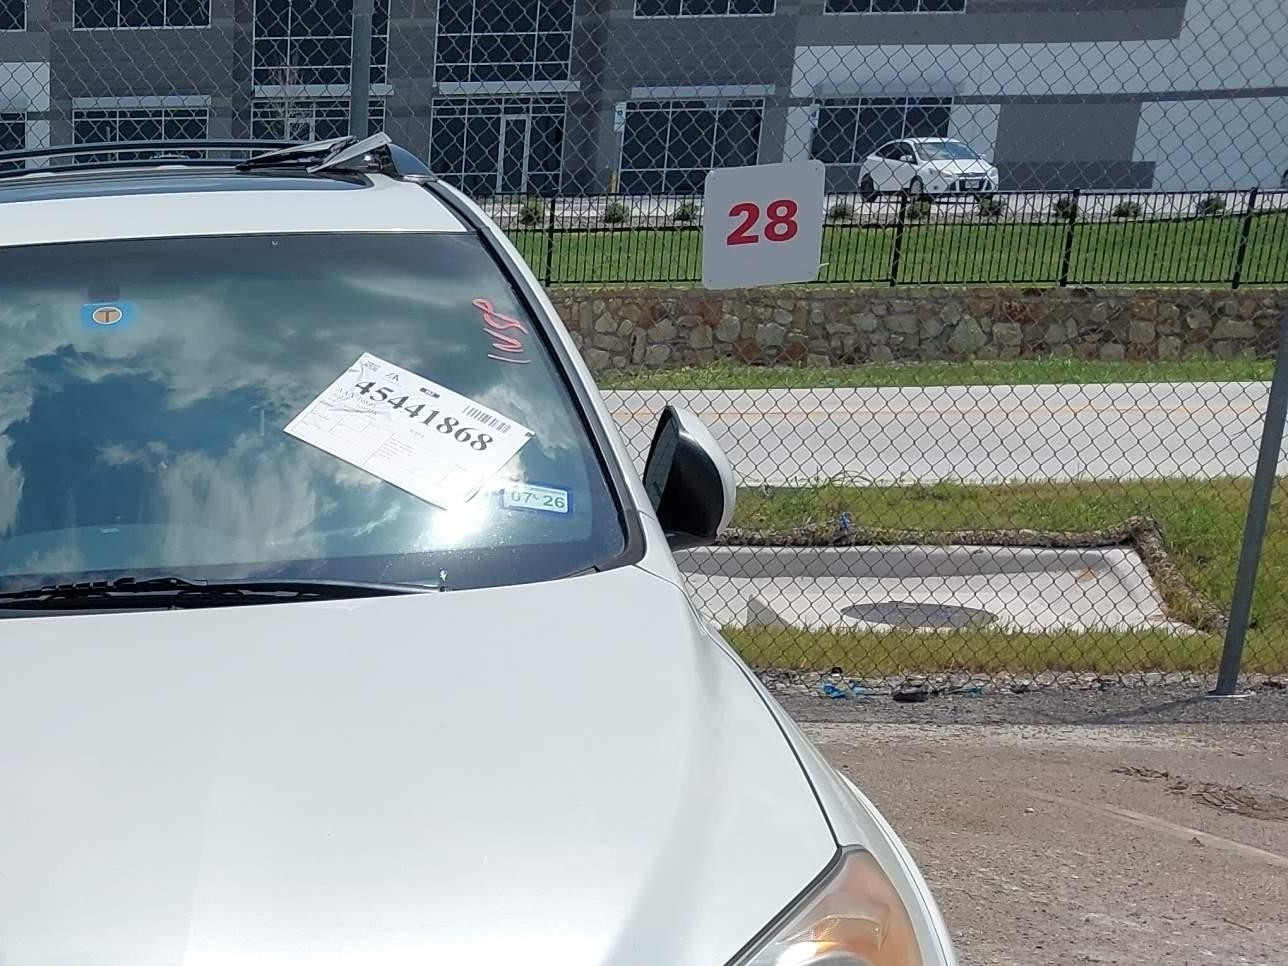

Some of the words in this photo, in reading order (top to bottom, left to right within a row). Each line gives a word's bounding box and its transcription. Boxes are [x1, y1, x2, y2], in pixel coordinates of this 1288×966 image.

[726, 199, 798, 246] 28
[354, 379, 494, 452] 45441868
[511, 489, 533, 503] 07
[542, 495, 566, 509] 26
